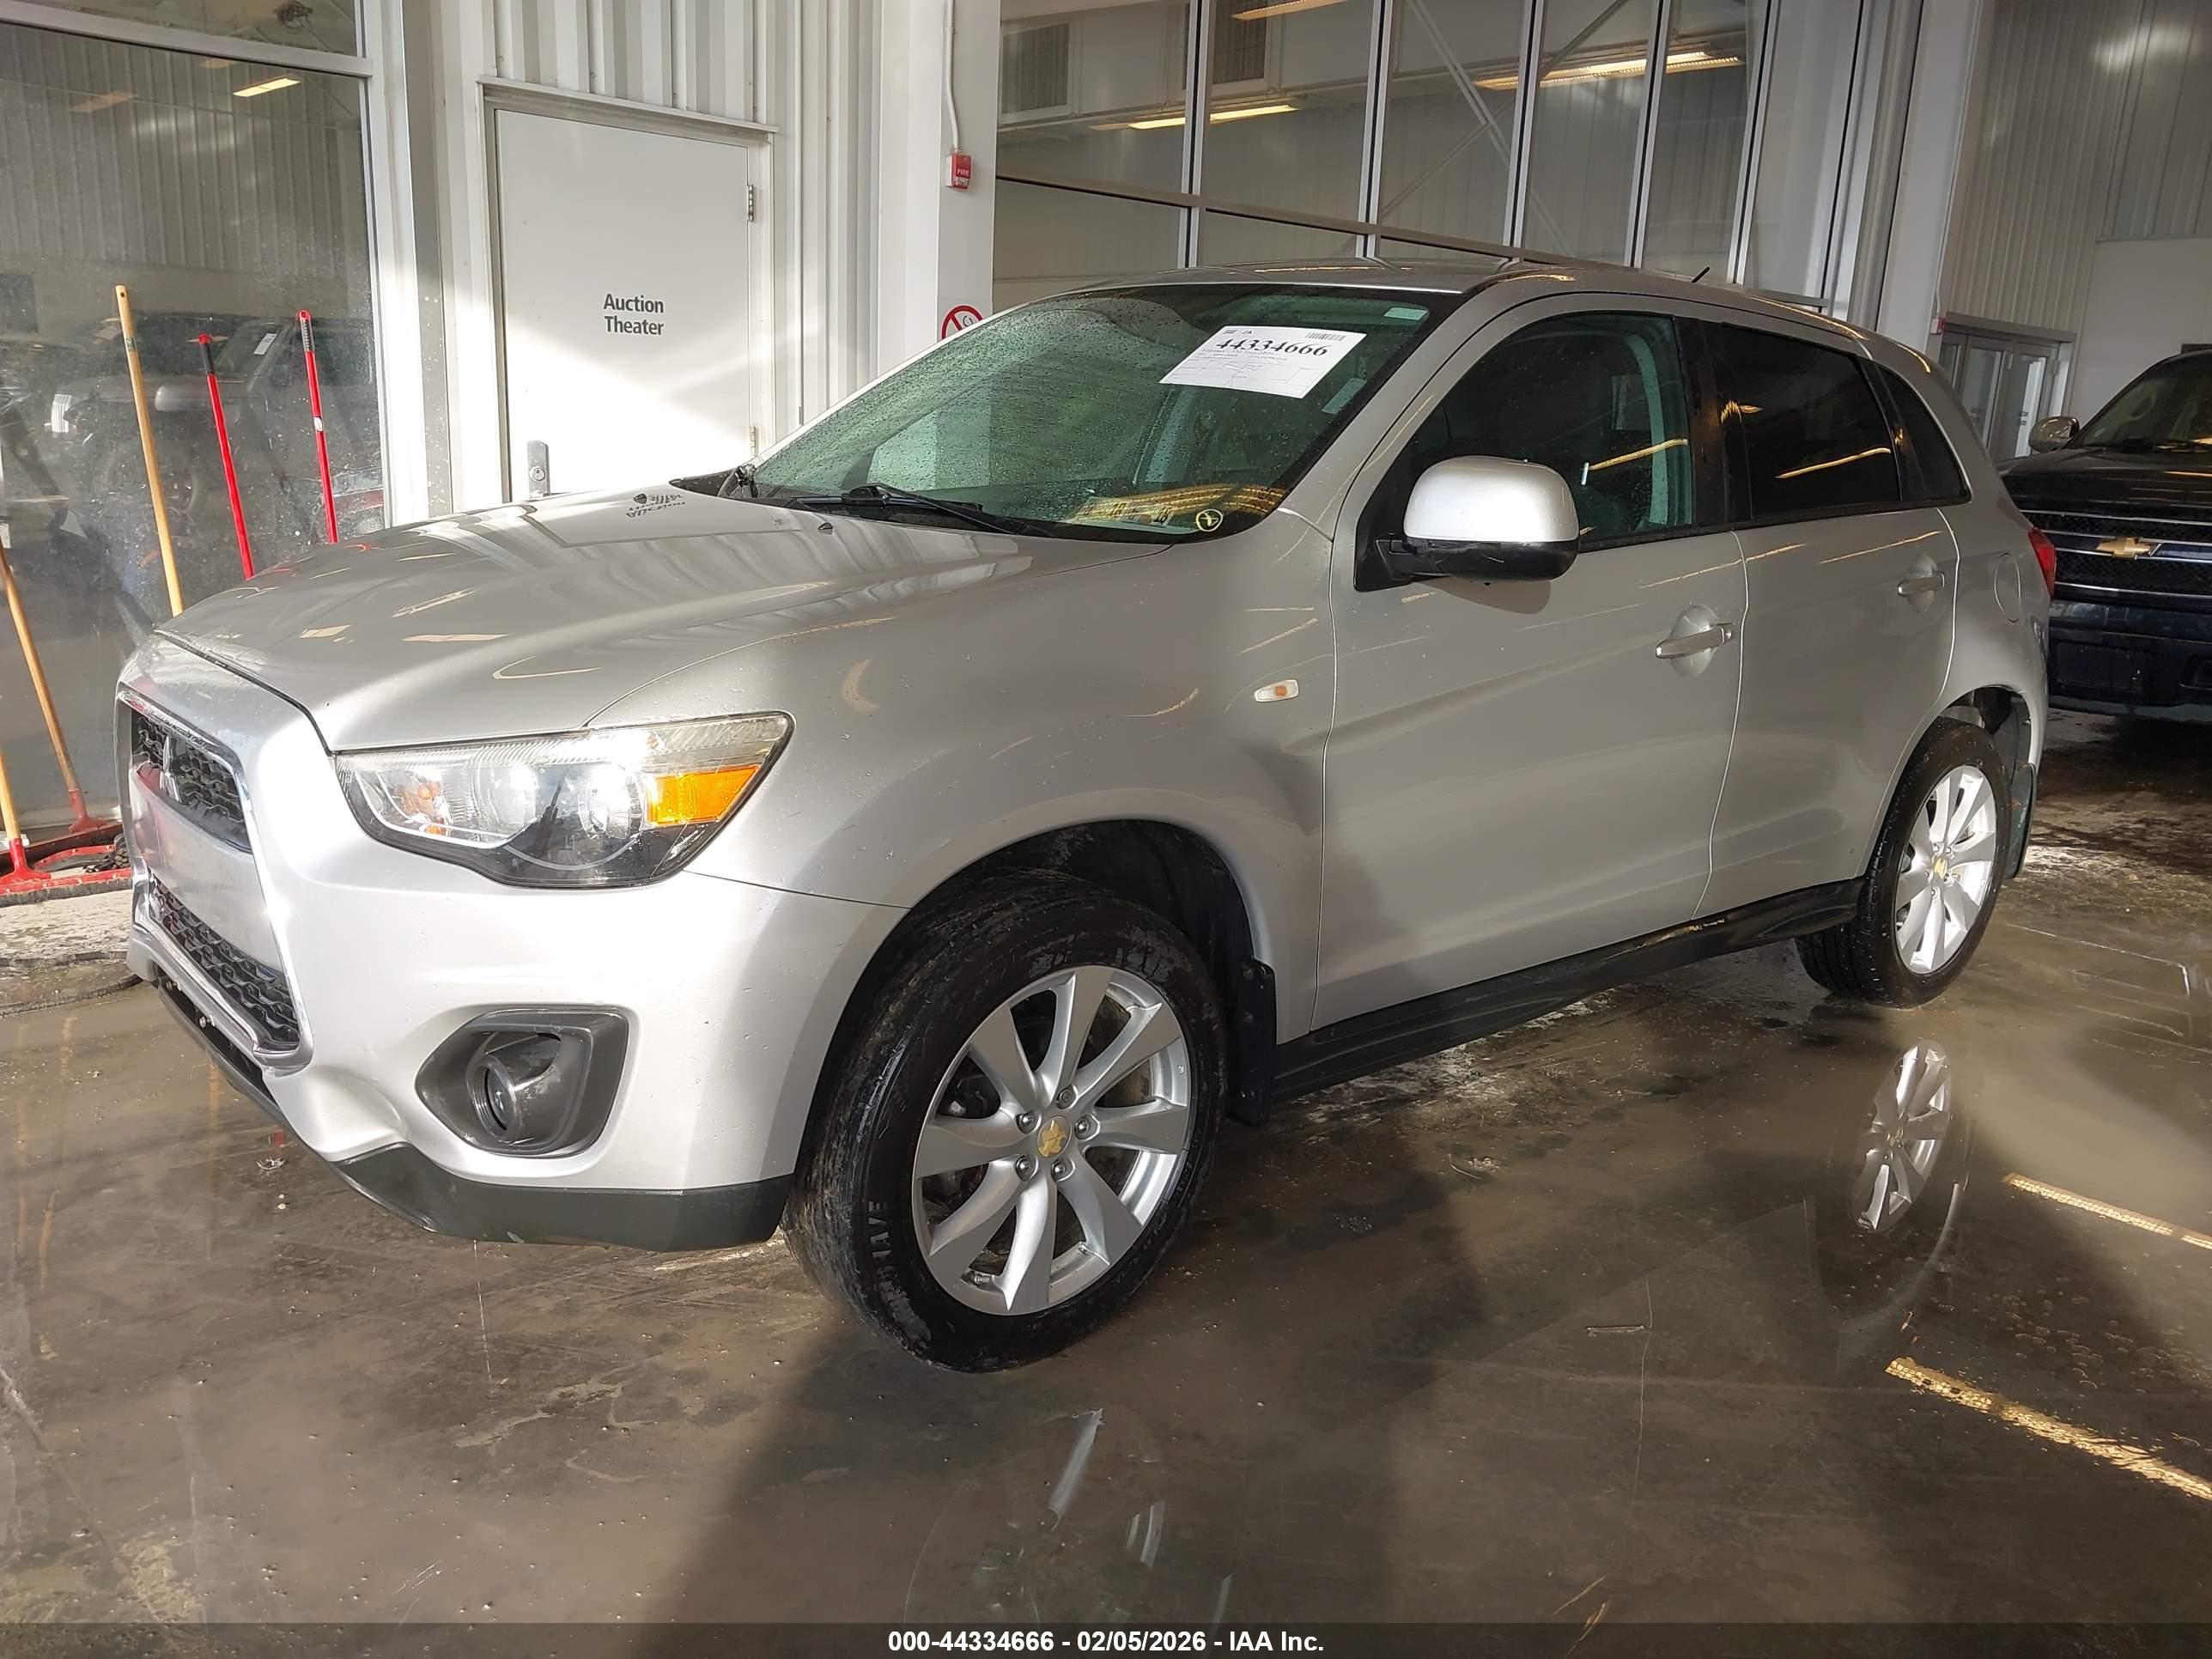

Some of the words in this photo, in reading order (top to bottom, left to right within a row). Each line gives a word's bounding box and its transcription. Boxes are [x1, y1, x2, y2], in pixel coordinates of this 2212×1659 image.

[957, 168, 969, 177] FIRE
[603, 293, 664, 313] Auction
[605, 315, 664, 335] Theater
[1215, 337, 1332, 356] 44334666
